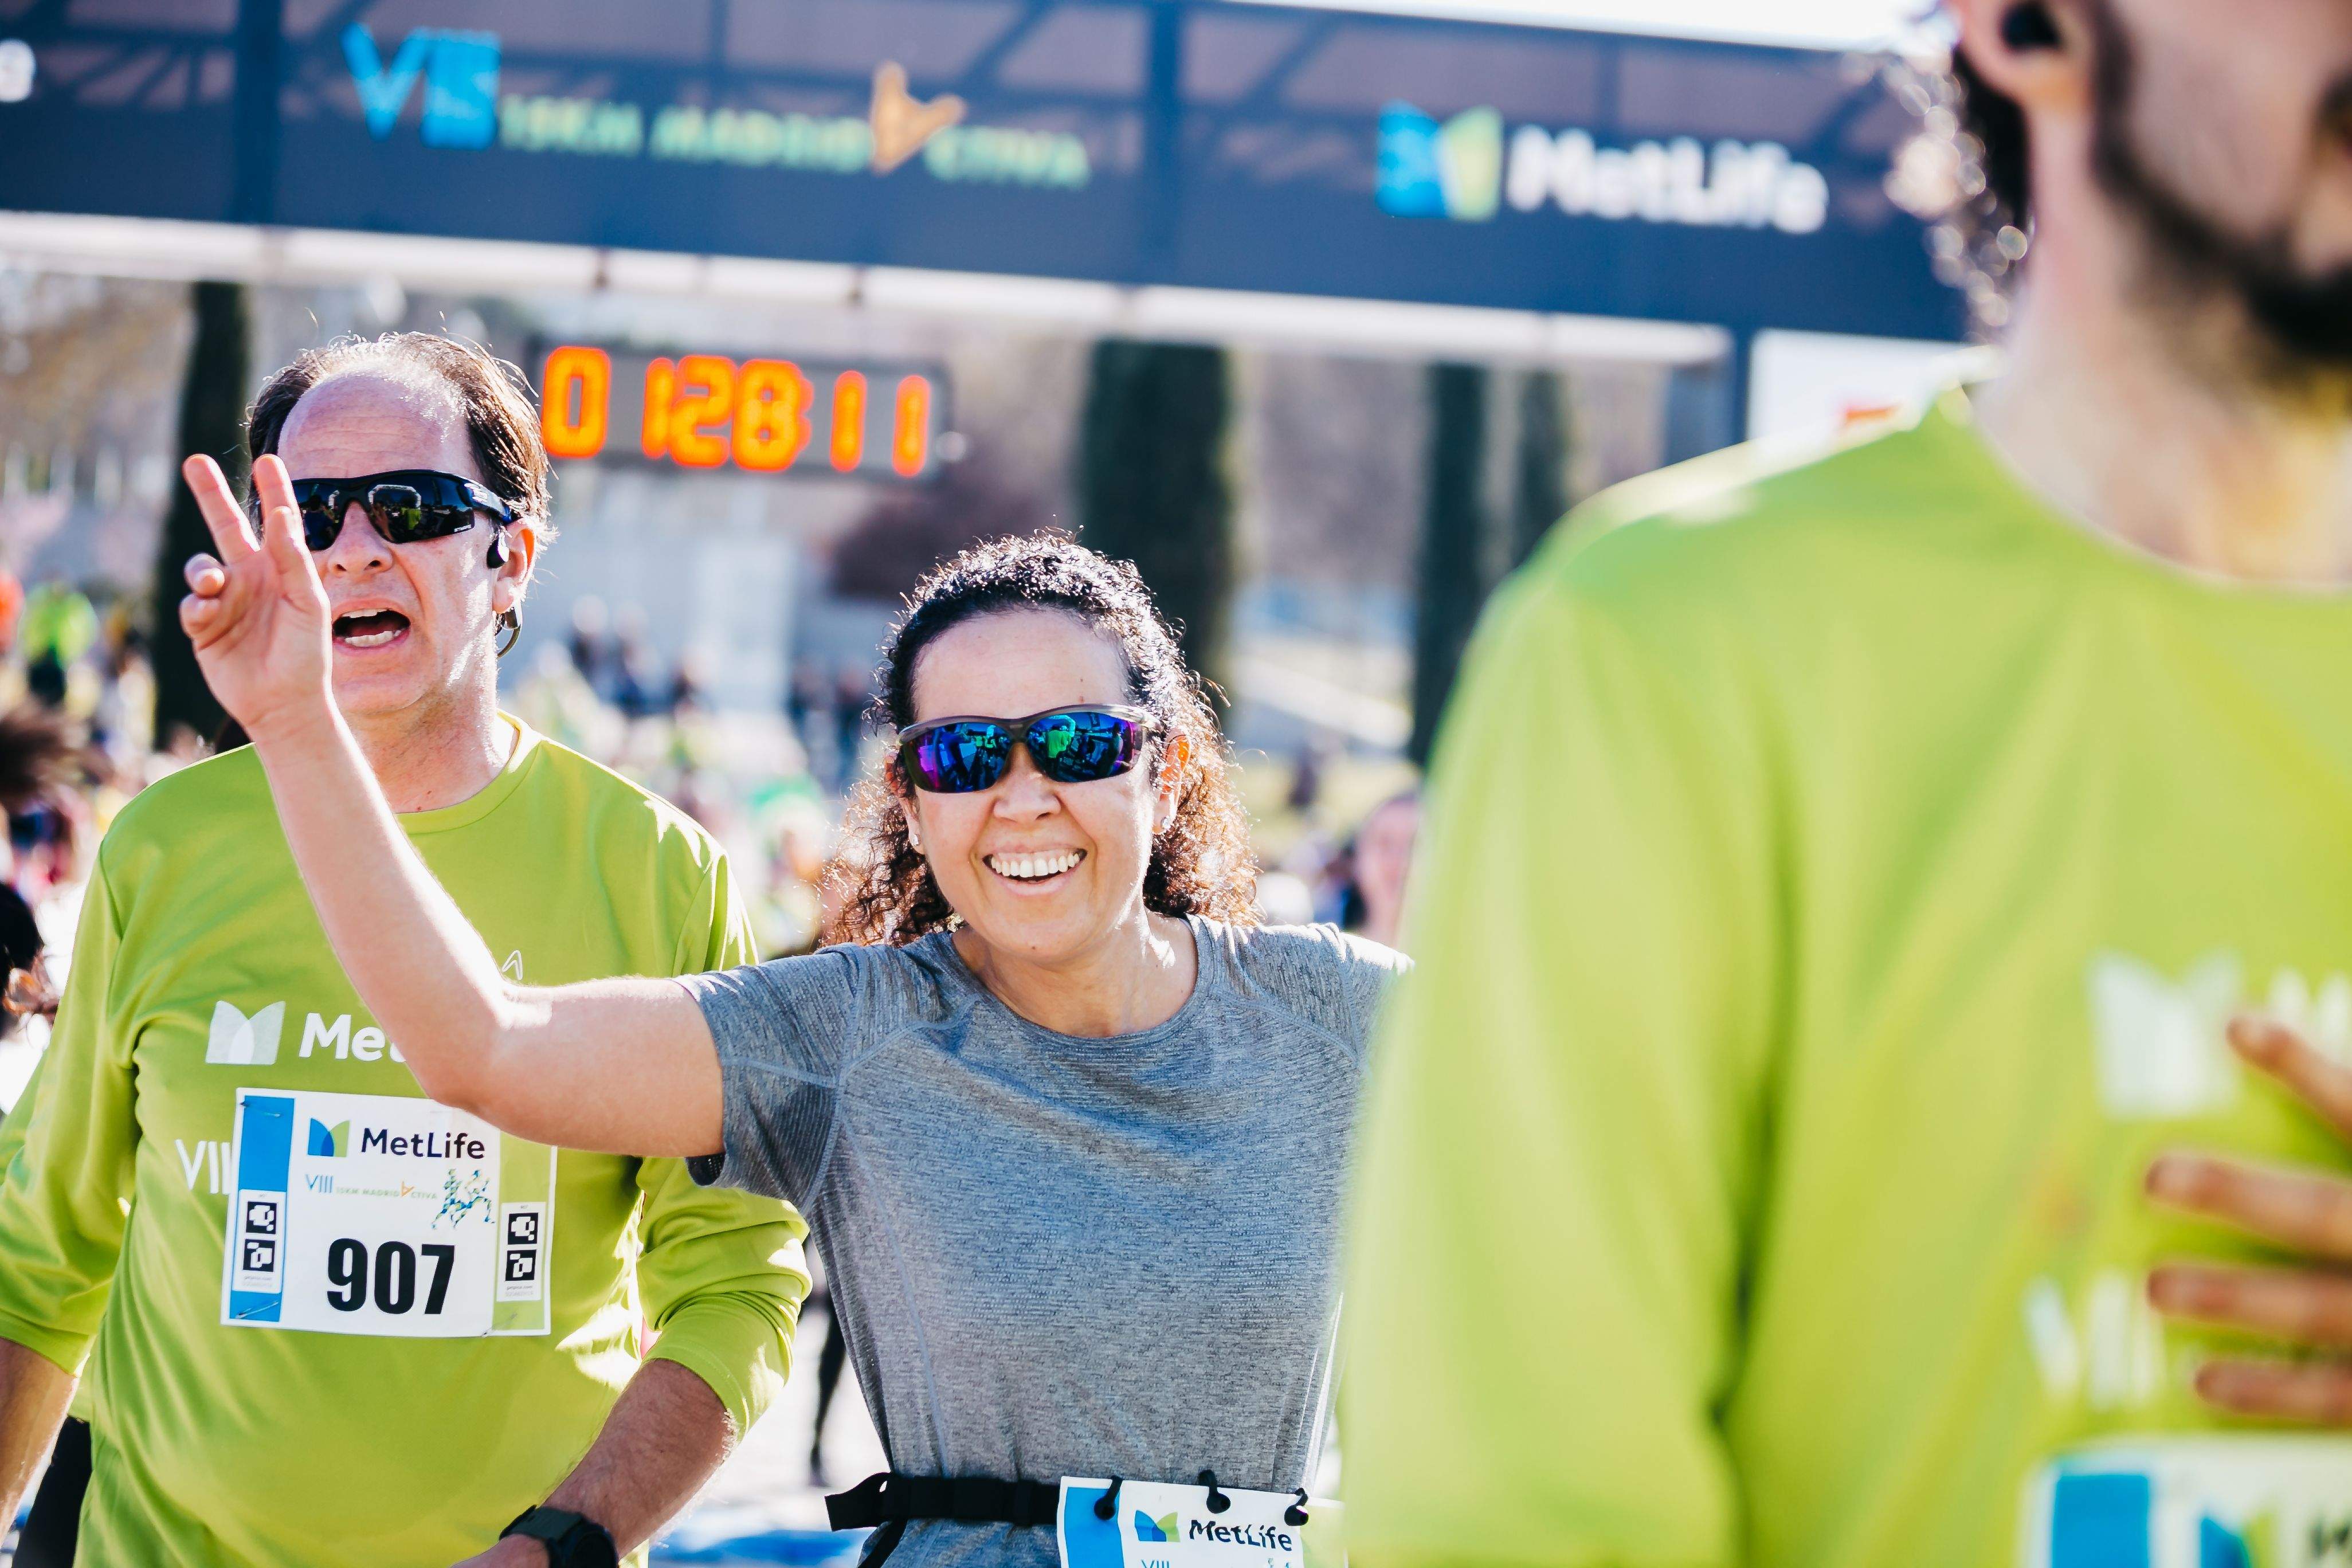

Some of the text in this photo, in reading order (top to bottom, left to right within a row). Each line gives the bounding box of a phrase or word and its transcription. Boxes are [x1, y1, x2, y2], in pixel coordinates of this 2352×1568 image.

[361, 1127, 485, 1159] MetLife
[305, 1174, 334, 1194] VIII
[327, 1238, 456, 1315] 907
[1189, 1519, 1292, 1552] MetLife
